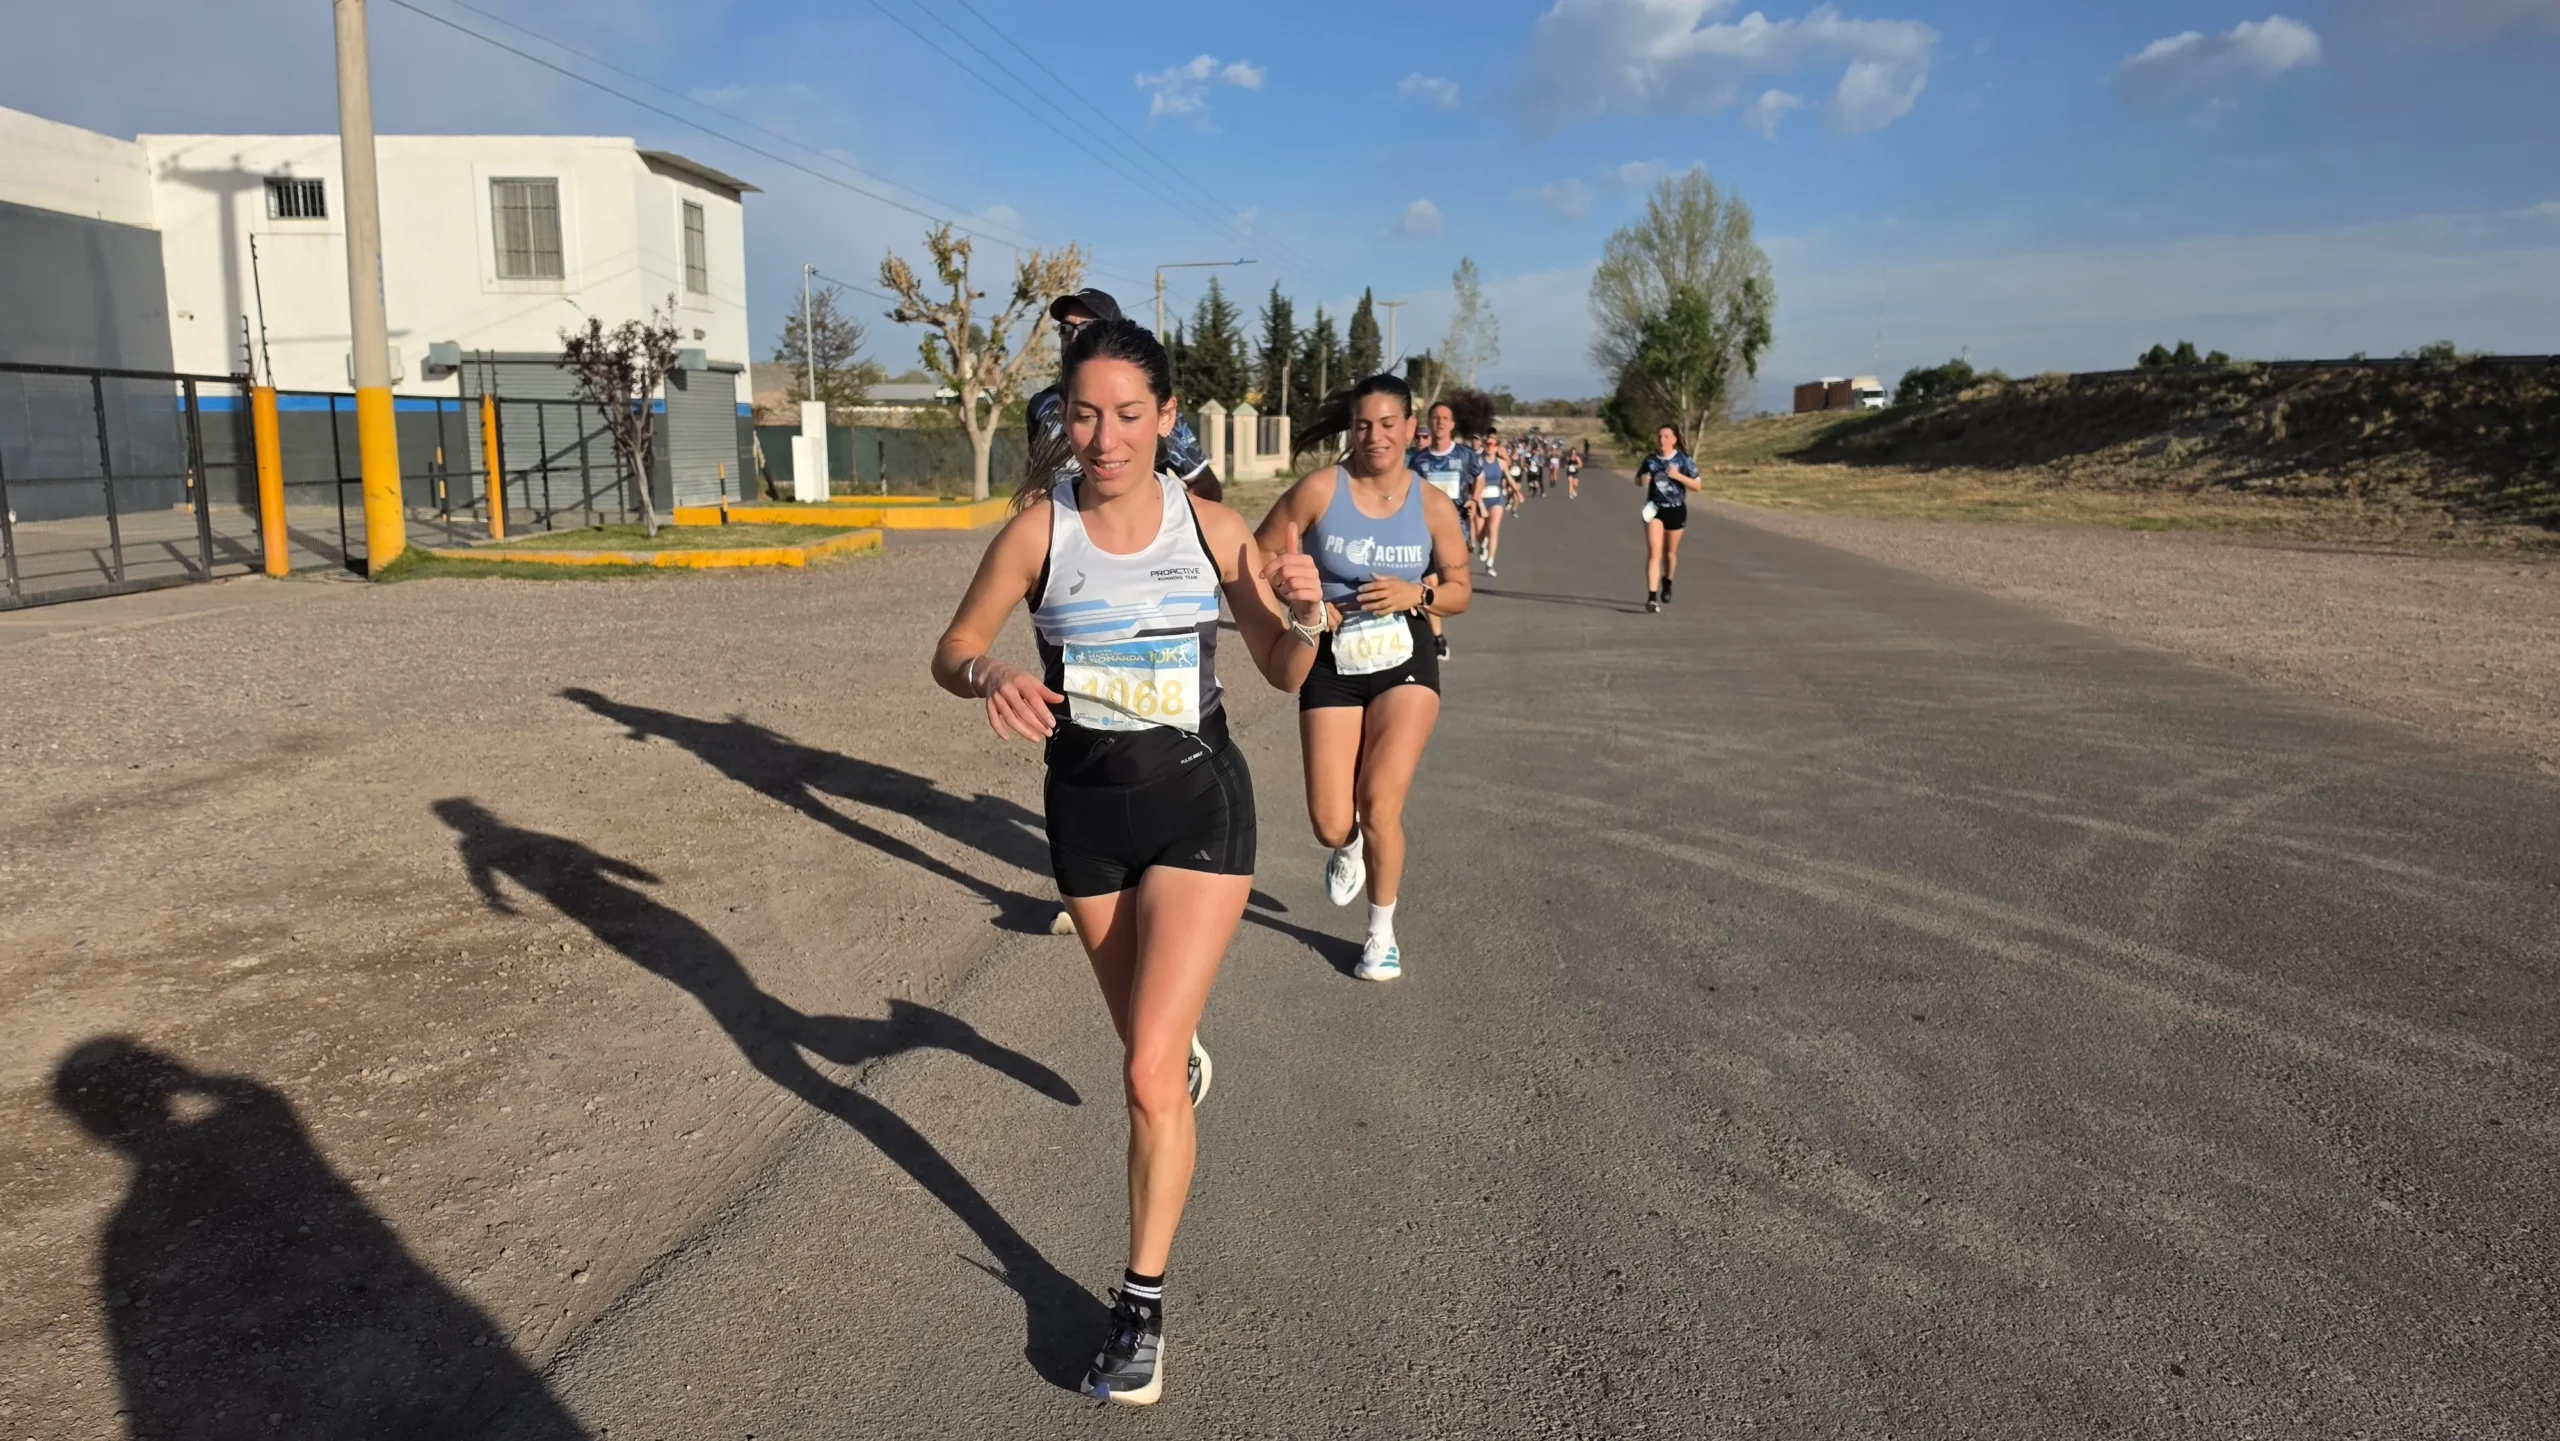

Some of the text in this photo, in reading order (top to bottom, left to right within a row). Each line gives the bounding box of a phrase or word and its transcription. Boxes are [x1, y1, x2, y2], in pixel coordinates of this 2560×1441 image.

[1324, 535, 1423, 563] PR ACTIVE
[1150, 567, 1201, 577] PROACTIVE
[1342, 631, 1404, 661] 1074
[1081, 676, 1184, 717] 1068
